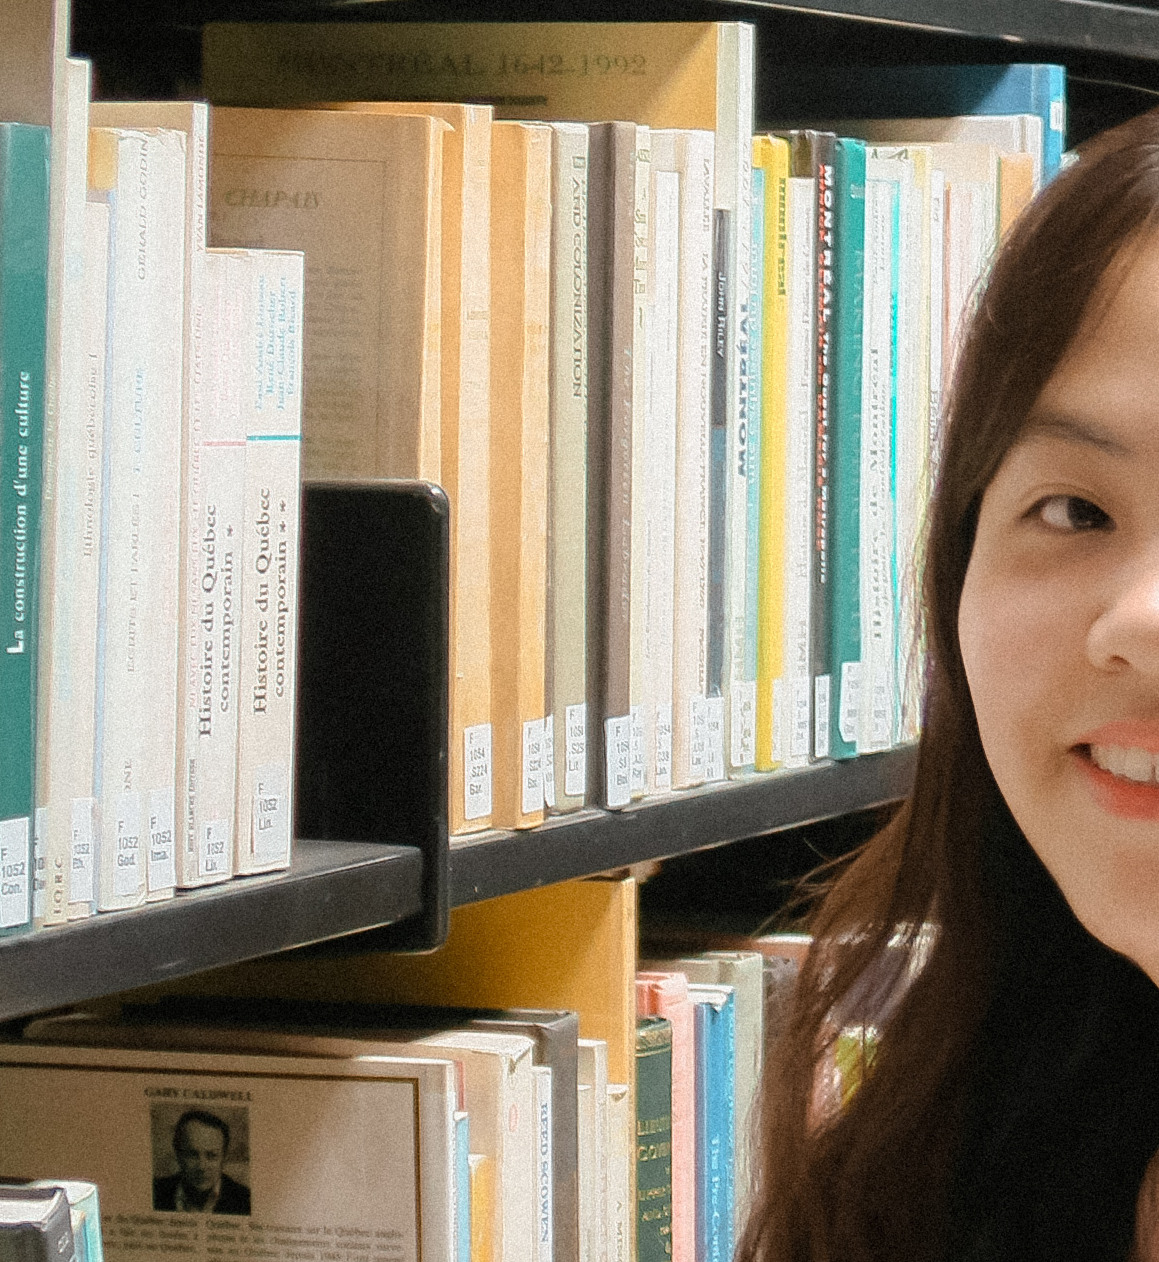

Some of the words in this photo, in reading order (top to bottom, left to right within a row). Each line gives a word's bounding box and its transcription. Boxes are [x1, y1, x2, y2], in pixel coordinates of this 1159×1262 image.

[139, 138, 149, 201] GODIN
[572, 177, 582, 228] AND
[572, 233, 583, 398] COLONIZATION
[15, 371, 30, 437] culture
[736, 303, 748, 477] MONTRÉAL
[868, 348, 880, 471] Montréal
[13, 445, 29, 496] d'une
[869, 486, 880, 517] de
[13, 504, 28, 621] construction
[202, 504, 219, 594] Québec
[256, 487, 273, 575] Québec
[201, 602, 214, 633] du
[256, 583, 269, 613] du
[275, 540, 289, 698] contemporain
[871, 537, 882, 639] Histoire
[6, 630, 25, 653] La
[220, 551, 234, 713] contemporain
[199, 639, 214, 737] Histoire
[253, 618, 268, 715] Histoire
[118, 820, 125, 833] F
[119, 836, 139, 851] 1052
[150, 815, 157, 829] F
[151, 830, 172, 846] 1052
[206, 826, 212, 840] F
[1, 862, 26, 878] 1052
[540, 1102, 550, 1156] REED
[540, 1160, 550, 1243] SCOWEN
